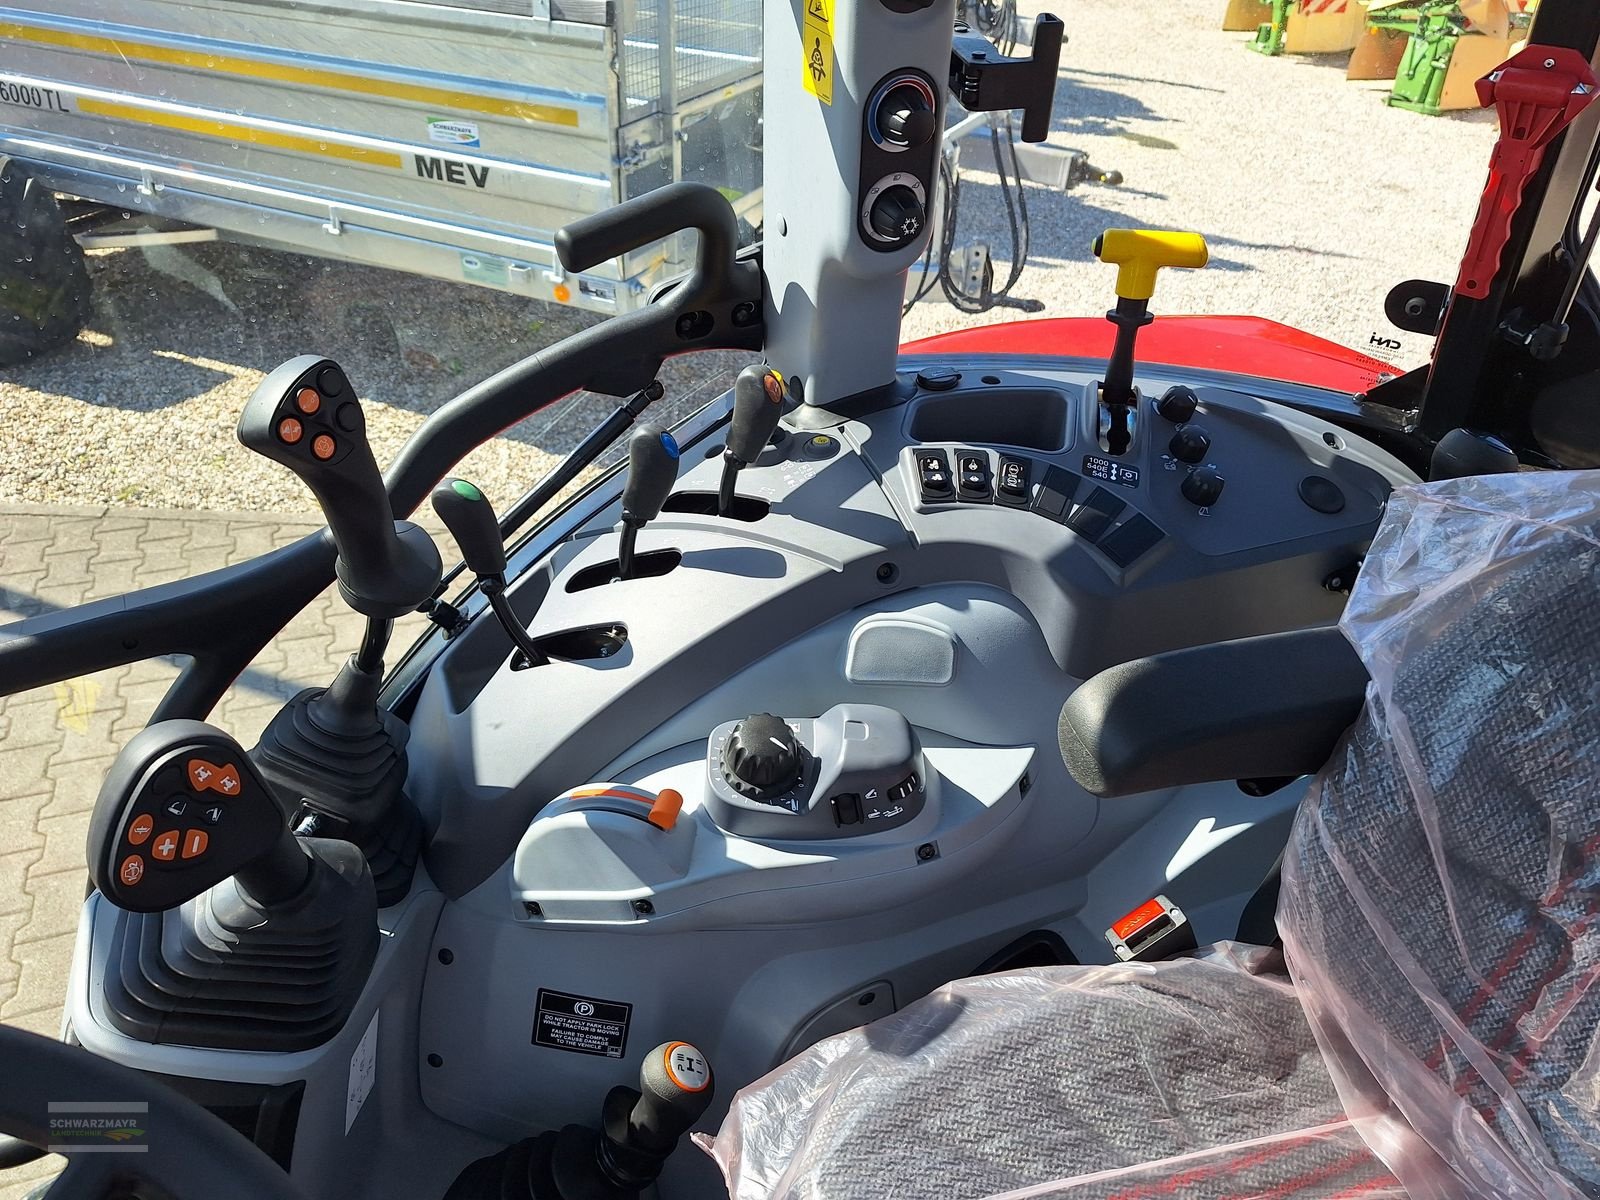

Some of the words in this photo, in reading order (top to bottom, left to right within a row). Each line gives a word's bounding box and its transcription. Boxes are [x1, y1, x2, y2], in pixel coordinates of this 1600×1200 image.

[414, 154, 490, 188] MEV
[1089, 457, 1109, 467] 1000
[1086, 463, 1108, 473] 540E
[1092, 470, 1108, 479] 540
[562, 1022, 590, 1032] TRACTOR
[597, 1028, 620, 1036] MOVING
[551, 1028, 576, 1037] FAILURE
[585, 1034, 609, 1042] COMPLY
[563, 1035, 584, 1043] CAUSE
[583, 1038, 609, 1047] DAMAGE
[578, 1042, 602, 1050] VEHICLE
